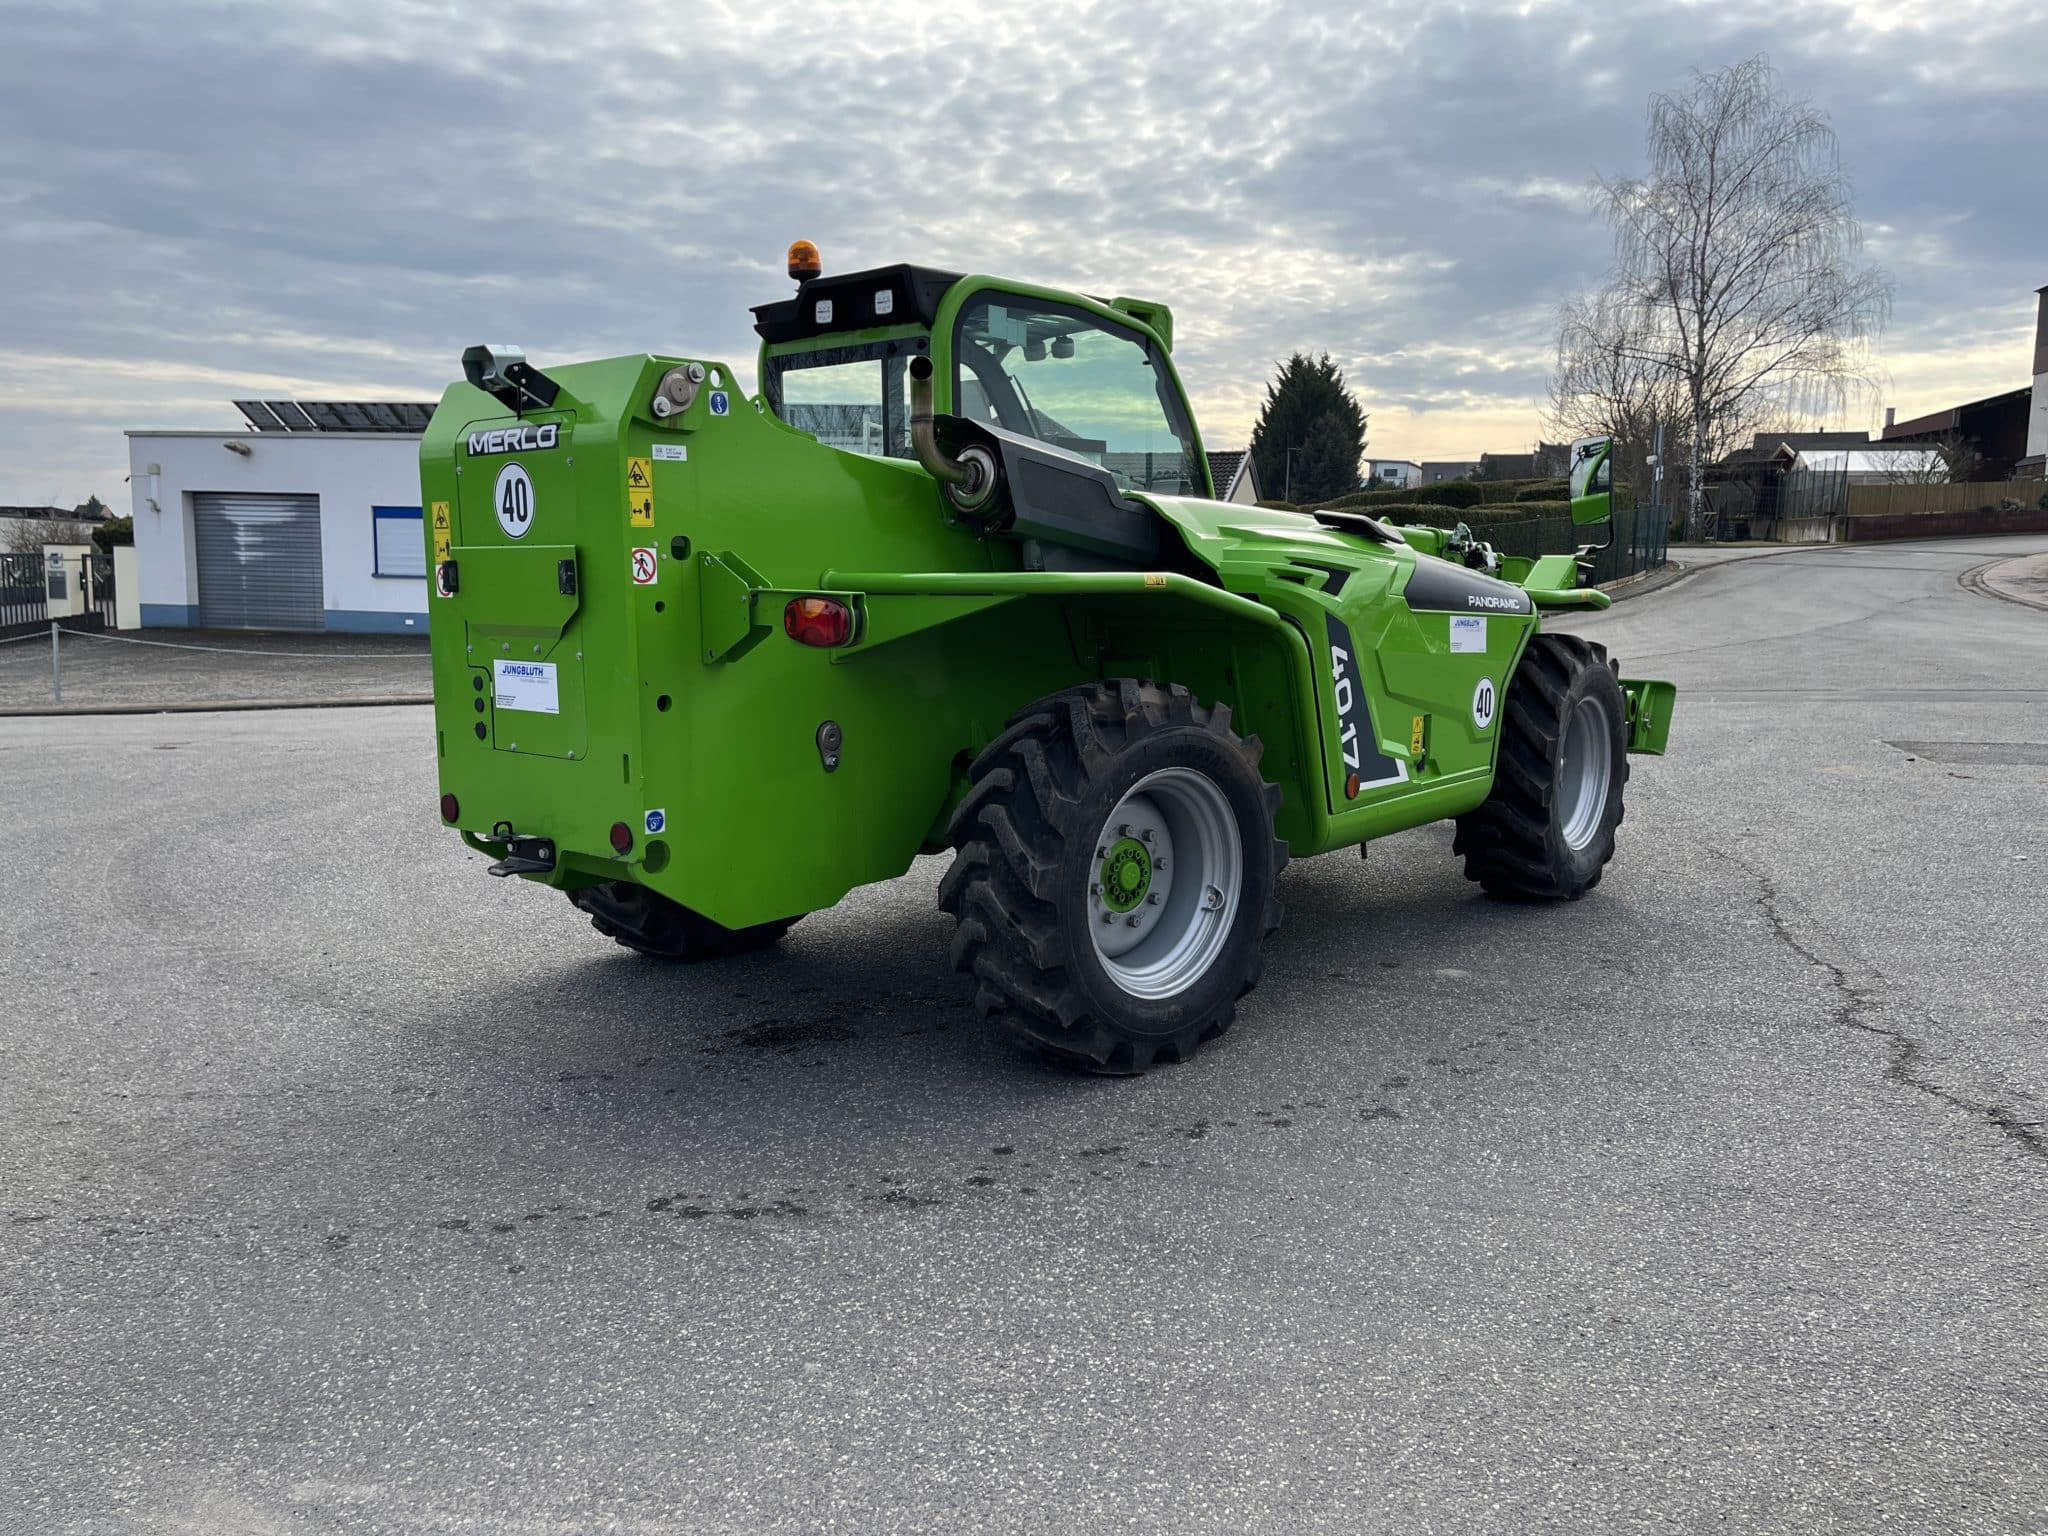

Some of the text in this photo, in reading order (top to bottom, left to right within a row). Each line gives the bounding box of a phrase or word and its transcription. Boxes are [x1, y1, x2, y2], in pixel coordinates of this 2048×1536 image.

[468, 424, 557, 455] MERLO
[502, 477, 529, 522] 40
[1468, 595, 1520, 609] PANORAMIC
[502, 664, 544, 677] JUNGBLUTH
[1331, 645, 1360, 769] 40.17
[1476, 687, 1492, 718] 40
